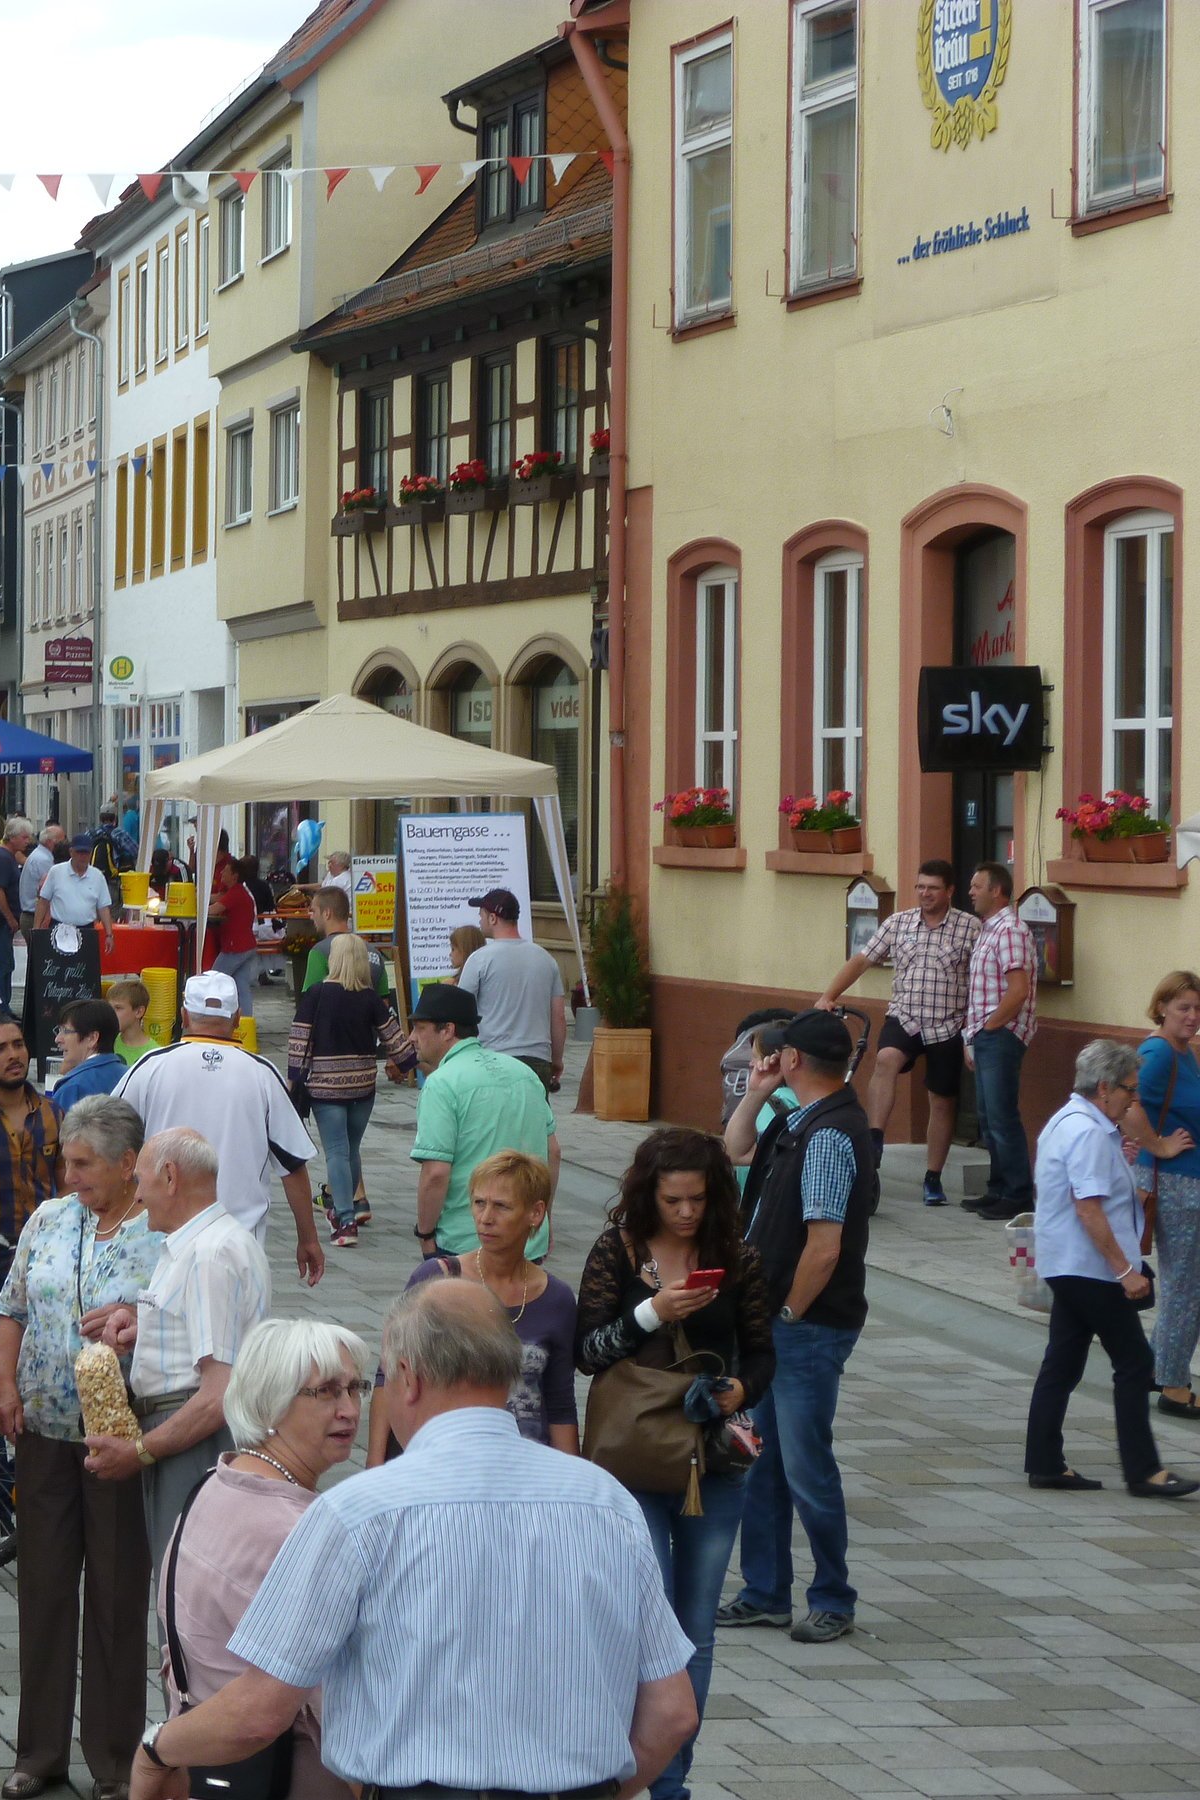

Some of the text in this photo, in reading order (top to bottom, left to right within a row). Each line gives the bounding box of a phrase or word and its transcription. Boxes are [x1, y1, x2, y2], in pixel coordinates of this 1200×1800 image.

[934, 31, 969, 74] Bräu
[947, 72, 963, 91] SEIT
[912, 235, 931, 261] der
[932, 221, 983, 256] fröhliche
[984, 205, 1031, 242] Schluck
[942, 690, 1031, 746] sky
[406, 823, 490, 842] Bauerngasse
